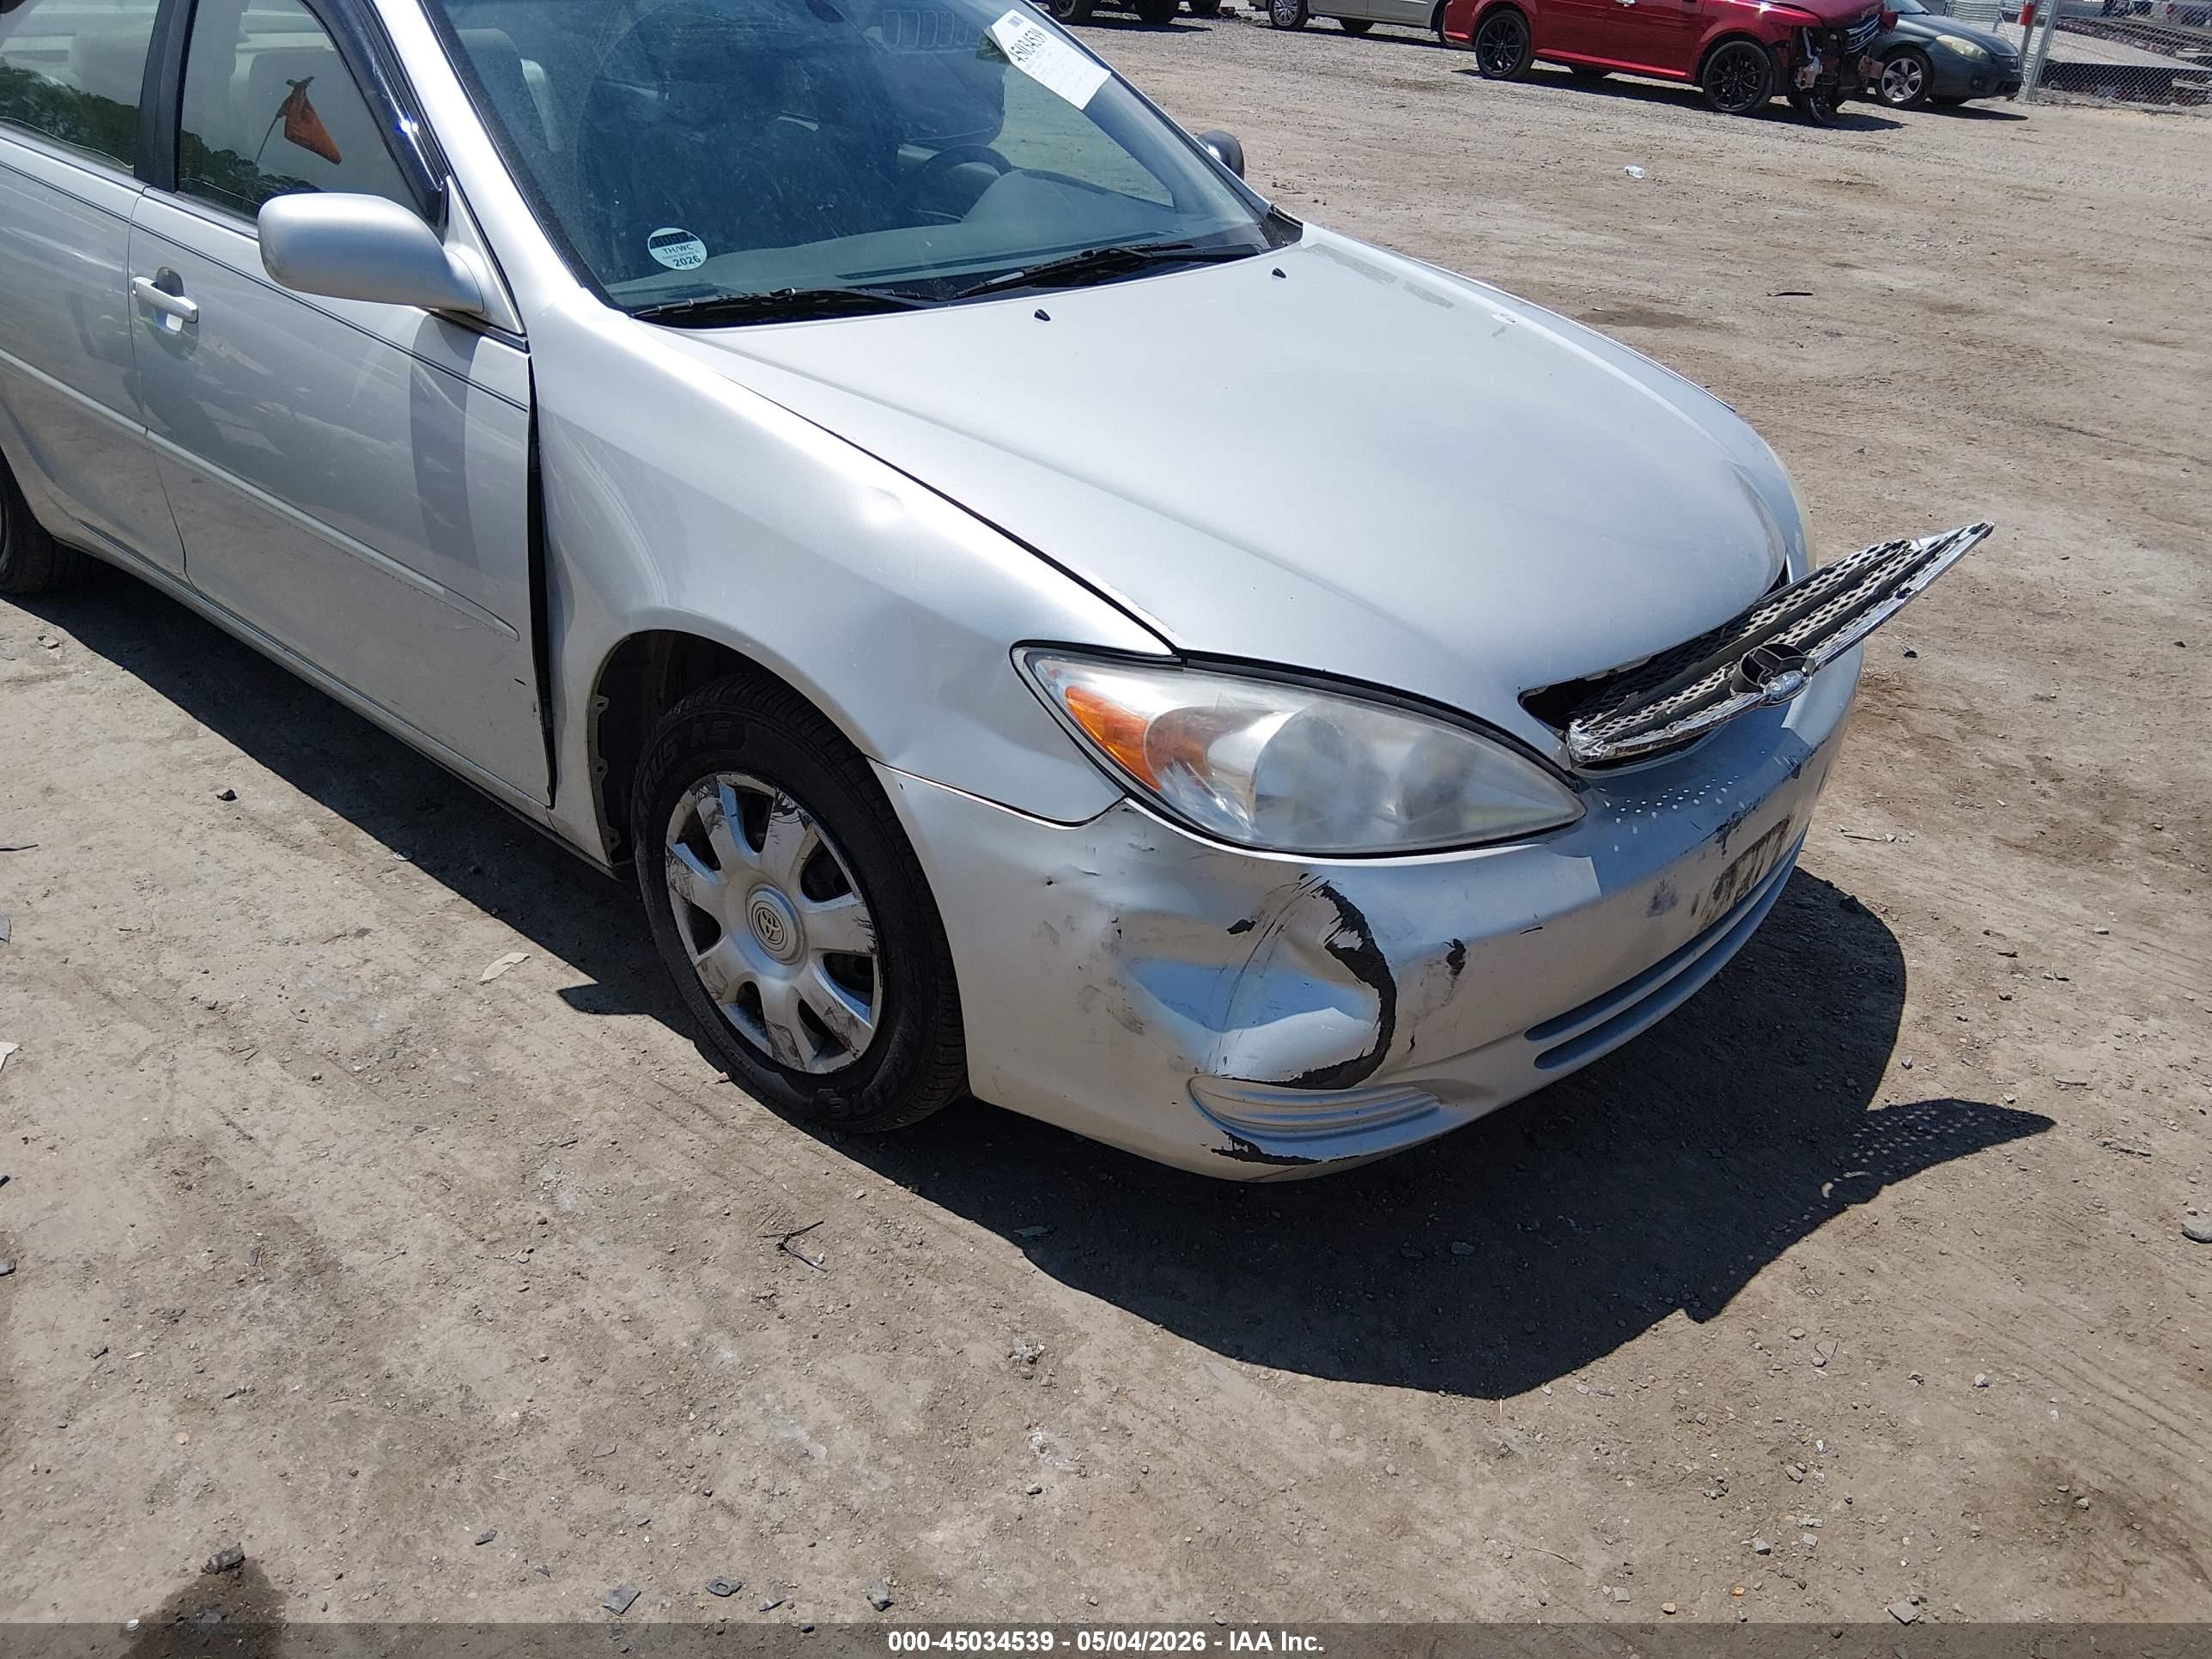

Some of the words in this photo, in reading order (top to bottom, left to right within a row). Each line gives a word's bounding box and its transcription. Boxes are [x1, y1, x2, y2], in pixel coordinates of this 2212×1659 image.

[1008, 27, 1048, 62] 45034539
[662, 244, 693, 255] TH/WC
[673, 255, 702, 266] 2026
